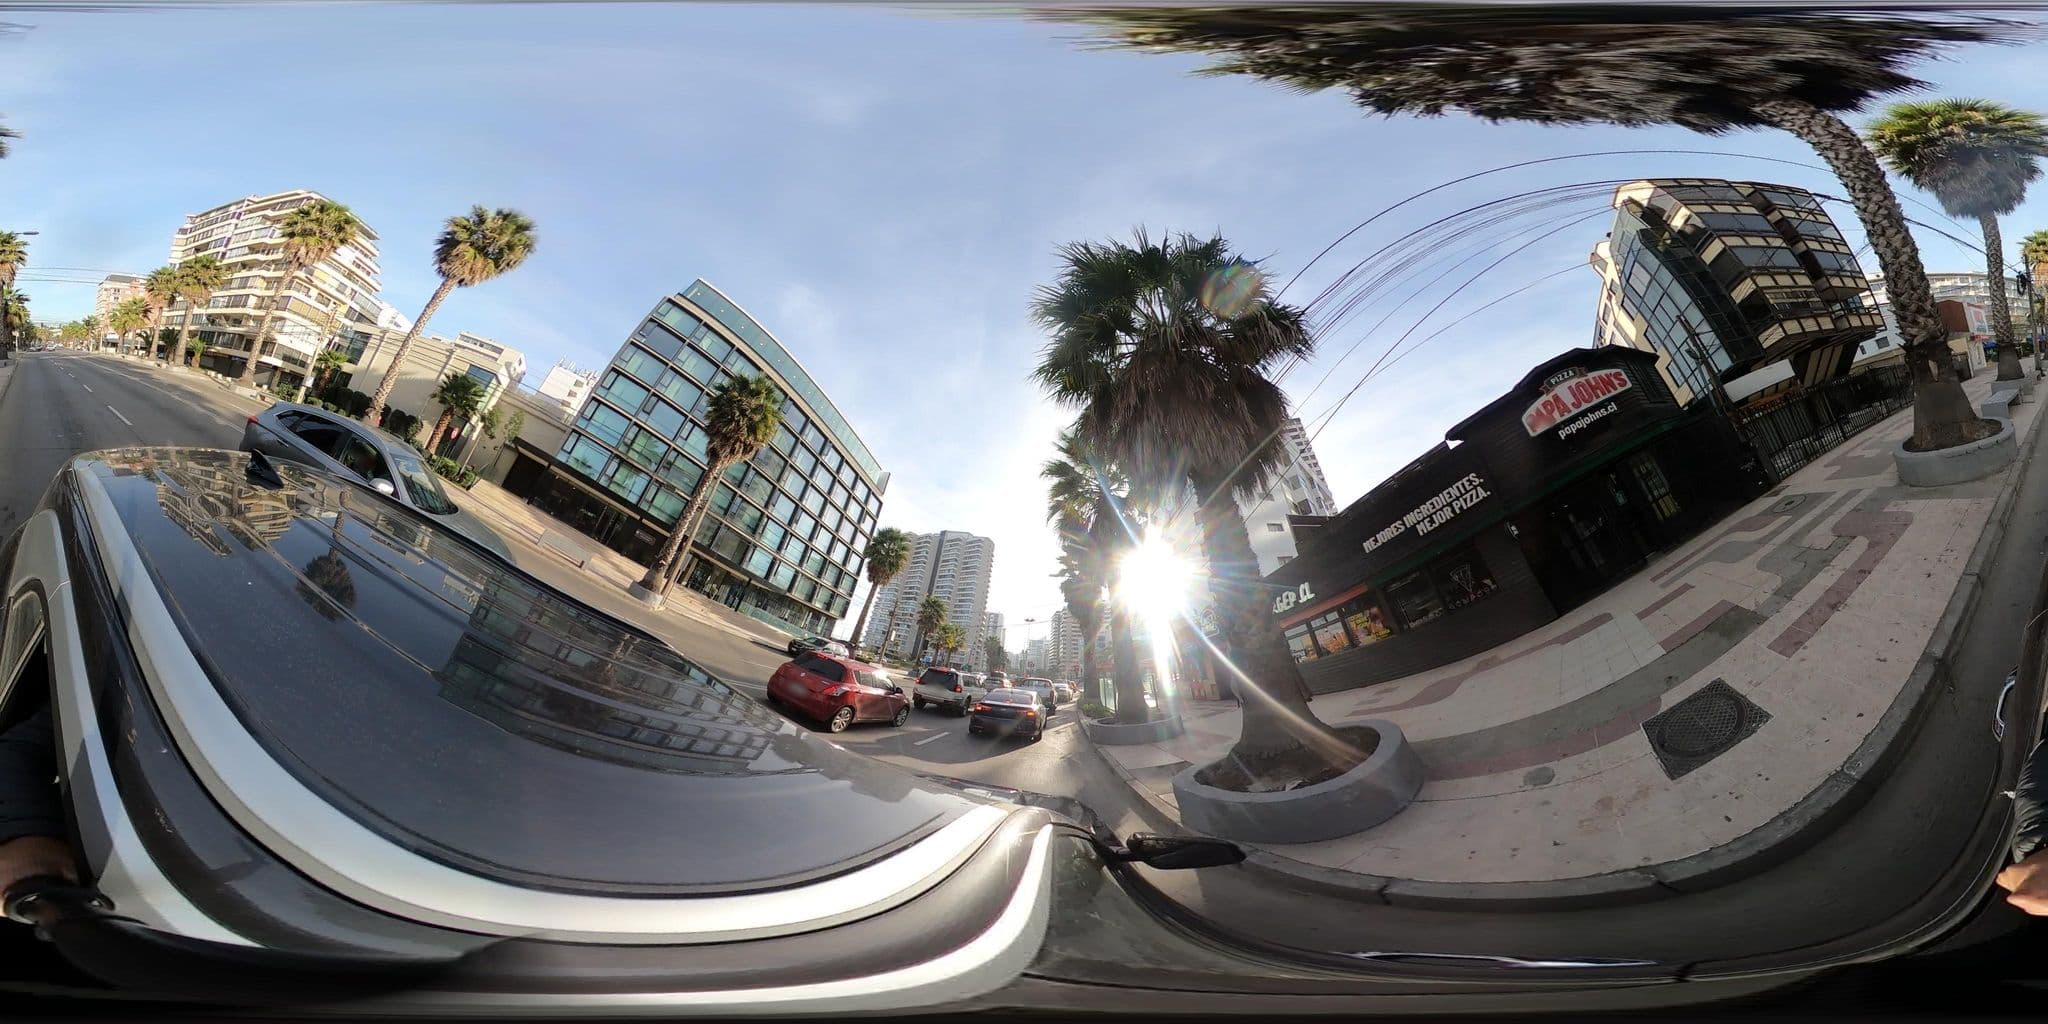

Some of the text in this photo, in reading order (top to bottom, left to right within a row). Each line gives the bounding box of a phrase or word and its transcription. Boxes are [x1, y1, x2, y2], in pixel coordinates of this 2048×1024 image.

[1550, 370, 1575, 385] PIZZA
[1568, 371, 1628, 409] JOHN'S
[1558, 402, 1618, 440] papajohns.cl
[1362, 472, 1484, 554] MEJORES INGREDIENTES.
[1415, 486, 1491, 536] MEJOR PIZZA.
